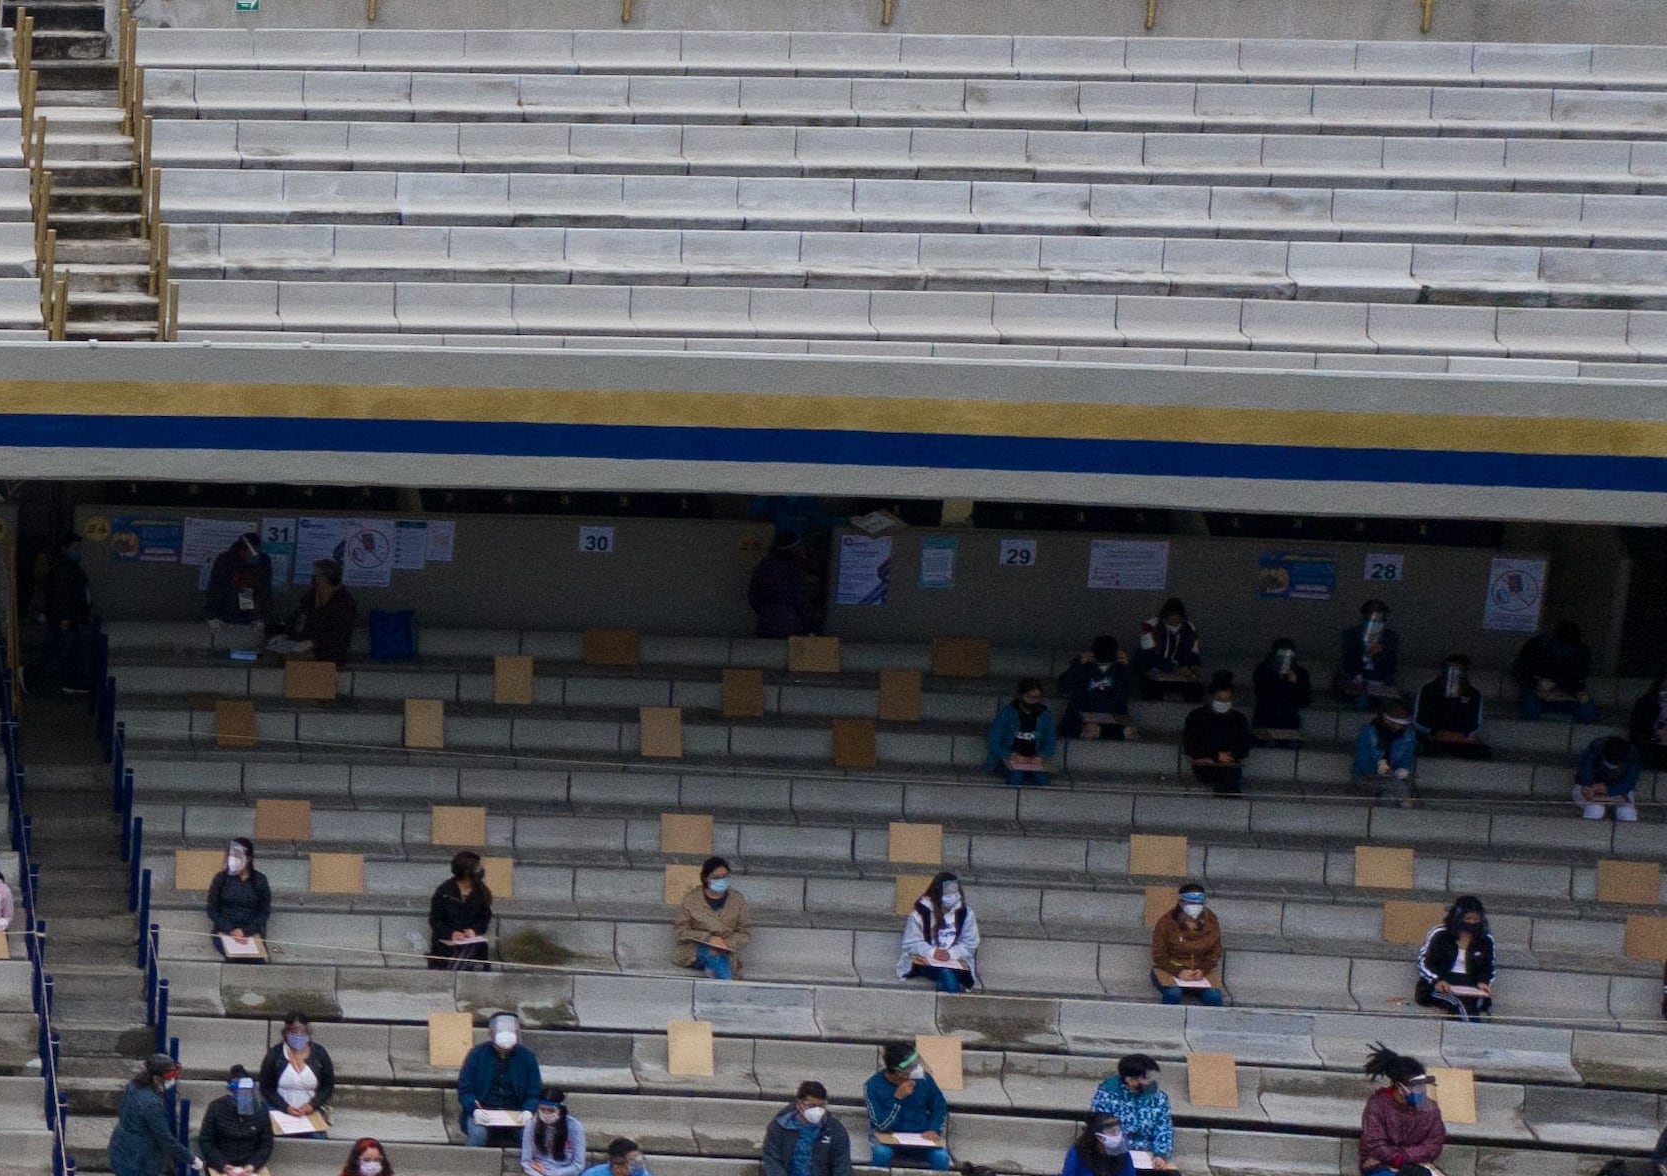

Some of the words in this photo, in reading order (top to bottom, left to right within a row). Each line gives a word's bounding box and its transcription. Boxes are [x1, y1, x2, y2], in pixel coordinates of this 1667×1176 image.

[268, 527, 289, 542] 31
[585, 535, 608, 550] 30
[1006, 549, 1031, 564] 29
[1372, 563, 1396, 579] 28
